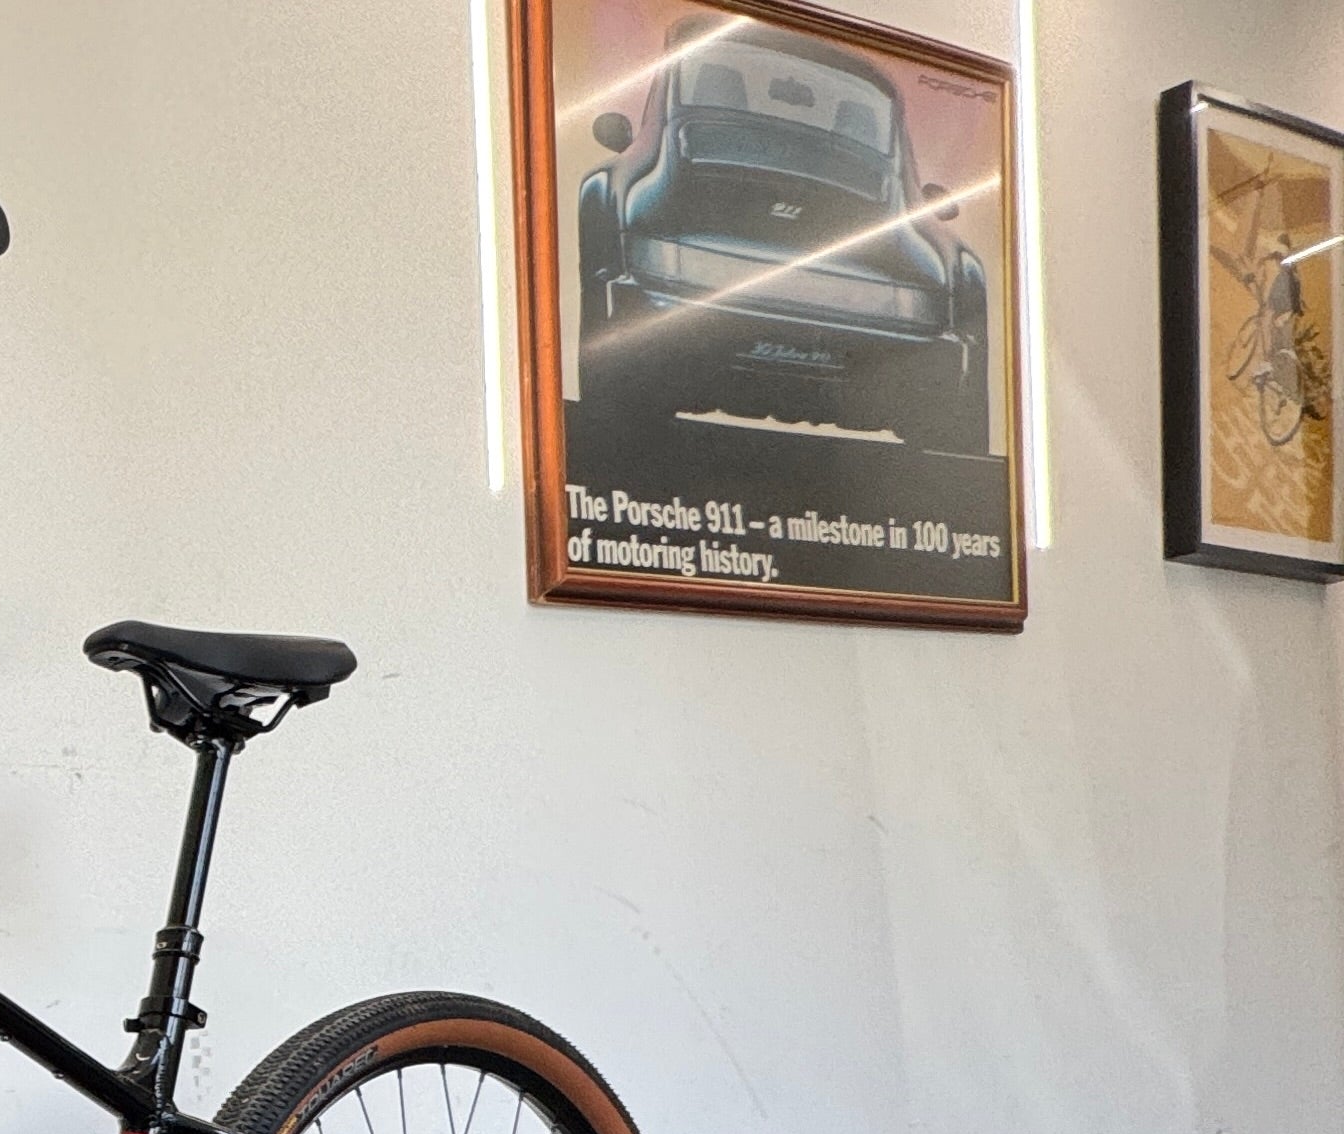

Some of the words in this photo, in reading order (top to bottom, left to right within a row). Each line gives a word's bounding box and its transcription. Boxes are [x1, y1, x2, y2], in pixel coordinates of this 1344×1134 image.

[565, 484, 608, 522] The
[612, 490, 702, 532] Porsche
[705, 500, 746, 536] 911
[768, 515, 783, 540] a
[787, 510, 885, 548] milestone
[889, 517, 908, 549] in
[913, 520, 948, 553] 100
[951, 532, 1001, 560] years
[567, 527, 593, 563] of
[596, 534, 697, 577] motoring
[699, 539, 780, 583] history.
